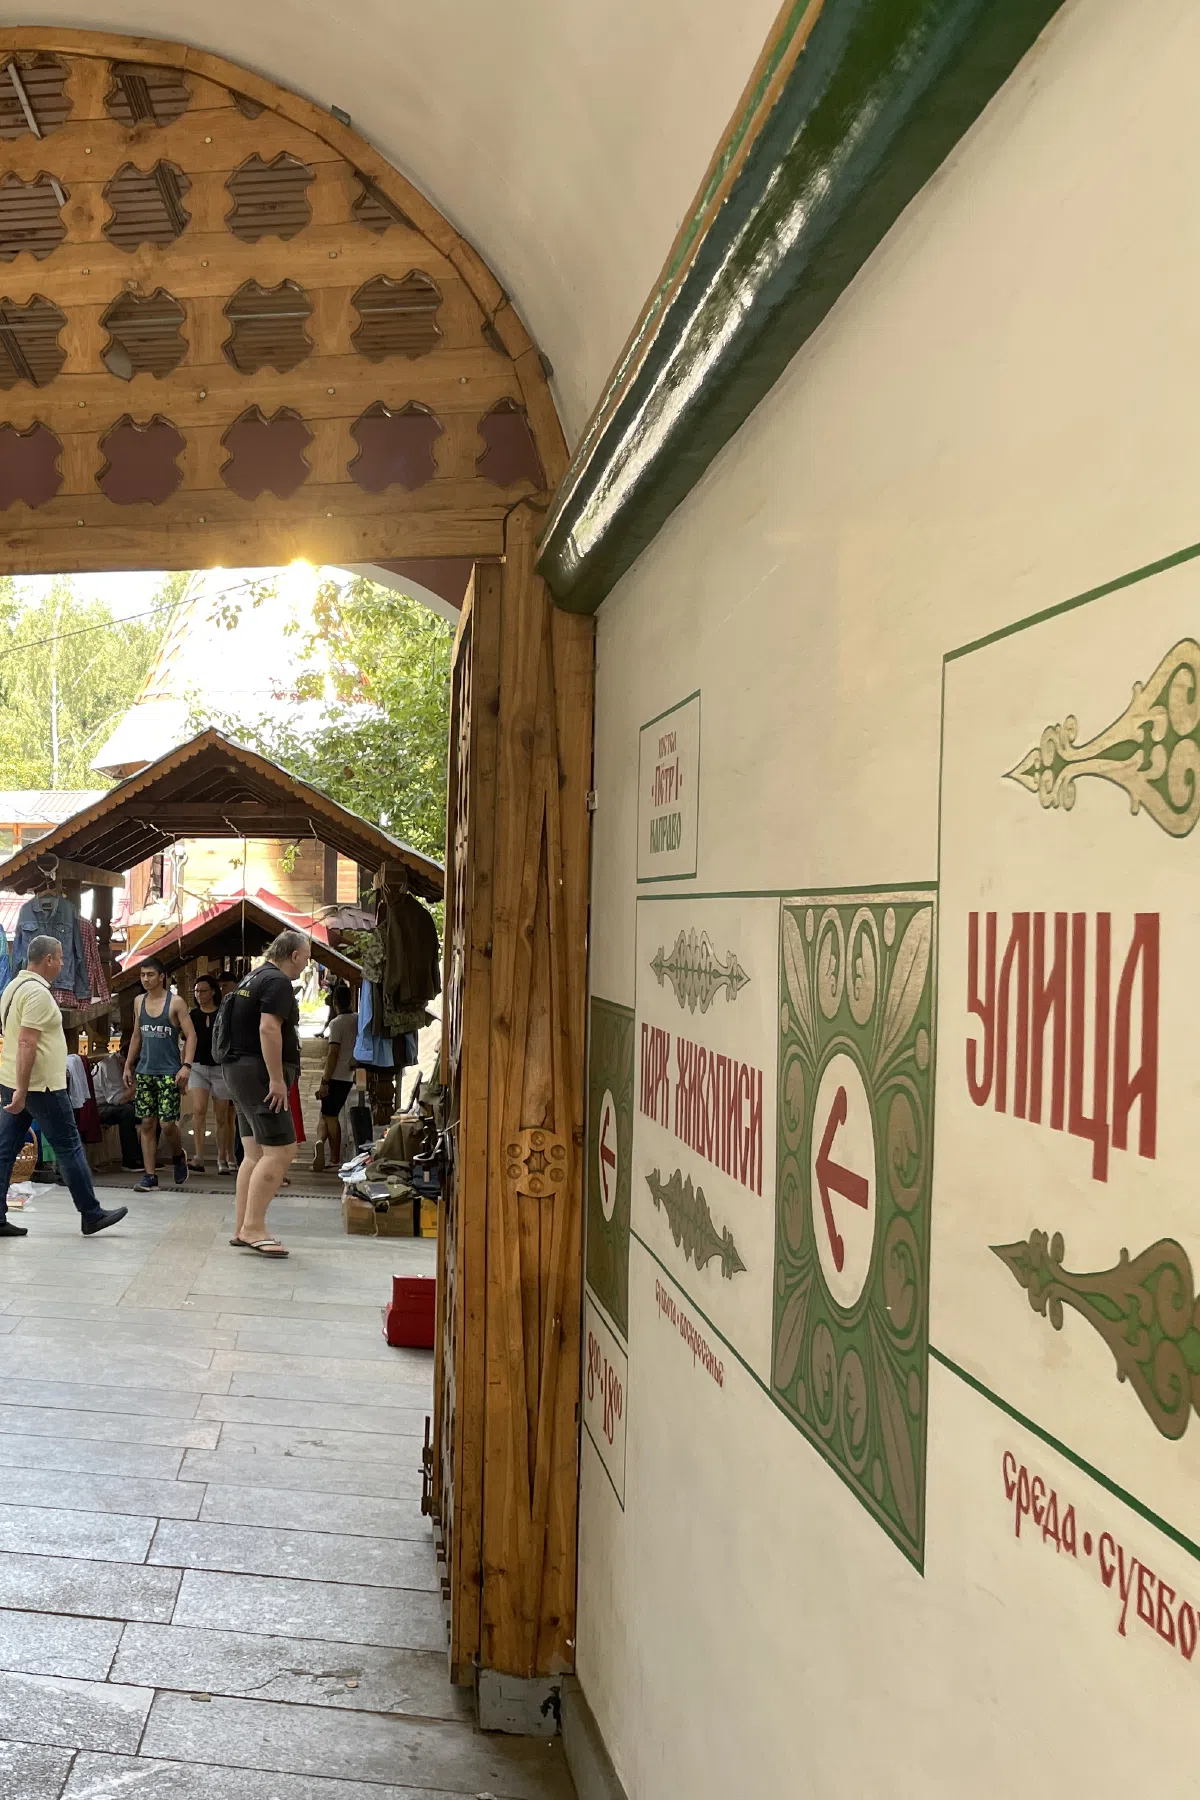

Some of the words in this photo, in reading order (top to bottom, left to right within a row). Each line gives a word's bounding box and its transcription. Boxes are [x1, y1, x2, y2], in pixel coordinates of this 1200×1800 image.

[640, 1022, 670, 1130] ПАРК
[675, 1036, 763, 1197] ЖИВОПИСИ
[965, 911, 1161, 1183] УЛИЦА
[1099, 1531, 1200, 1662] суббо
